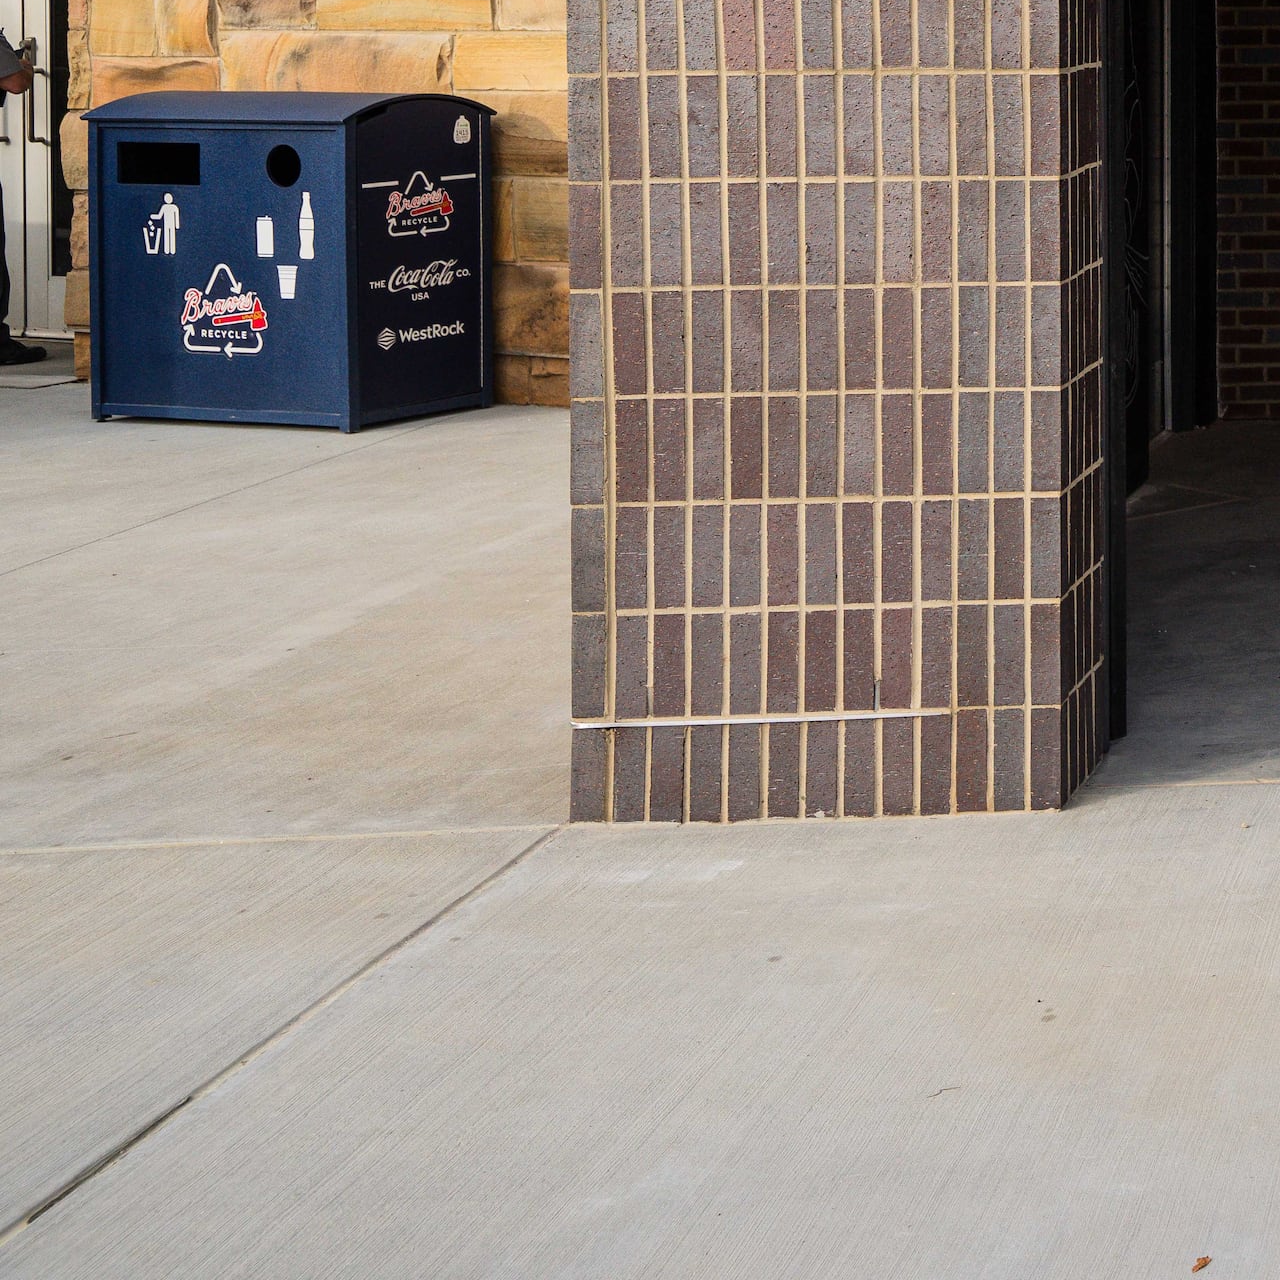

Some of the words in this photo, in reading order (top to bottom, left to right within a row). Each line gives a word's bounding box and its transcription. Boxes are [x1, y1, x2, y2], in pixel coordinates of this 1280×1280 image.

[387, 190, 442, 219] Braves
[402, 216, 438, 227] RECYCLE
[369, 280, 386, 290] THE
[388, 259, 458, 293] Coca-Cola
[456, 268, 472, 278] CO.
[181, 288, 252, 324] Braves
[411, 291, 430, 302] USA
[200, 329, 247, 341] RECYCLE
[398, 320, 465, 344] WestRock
